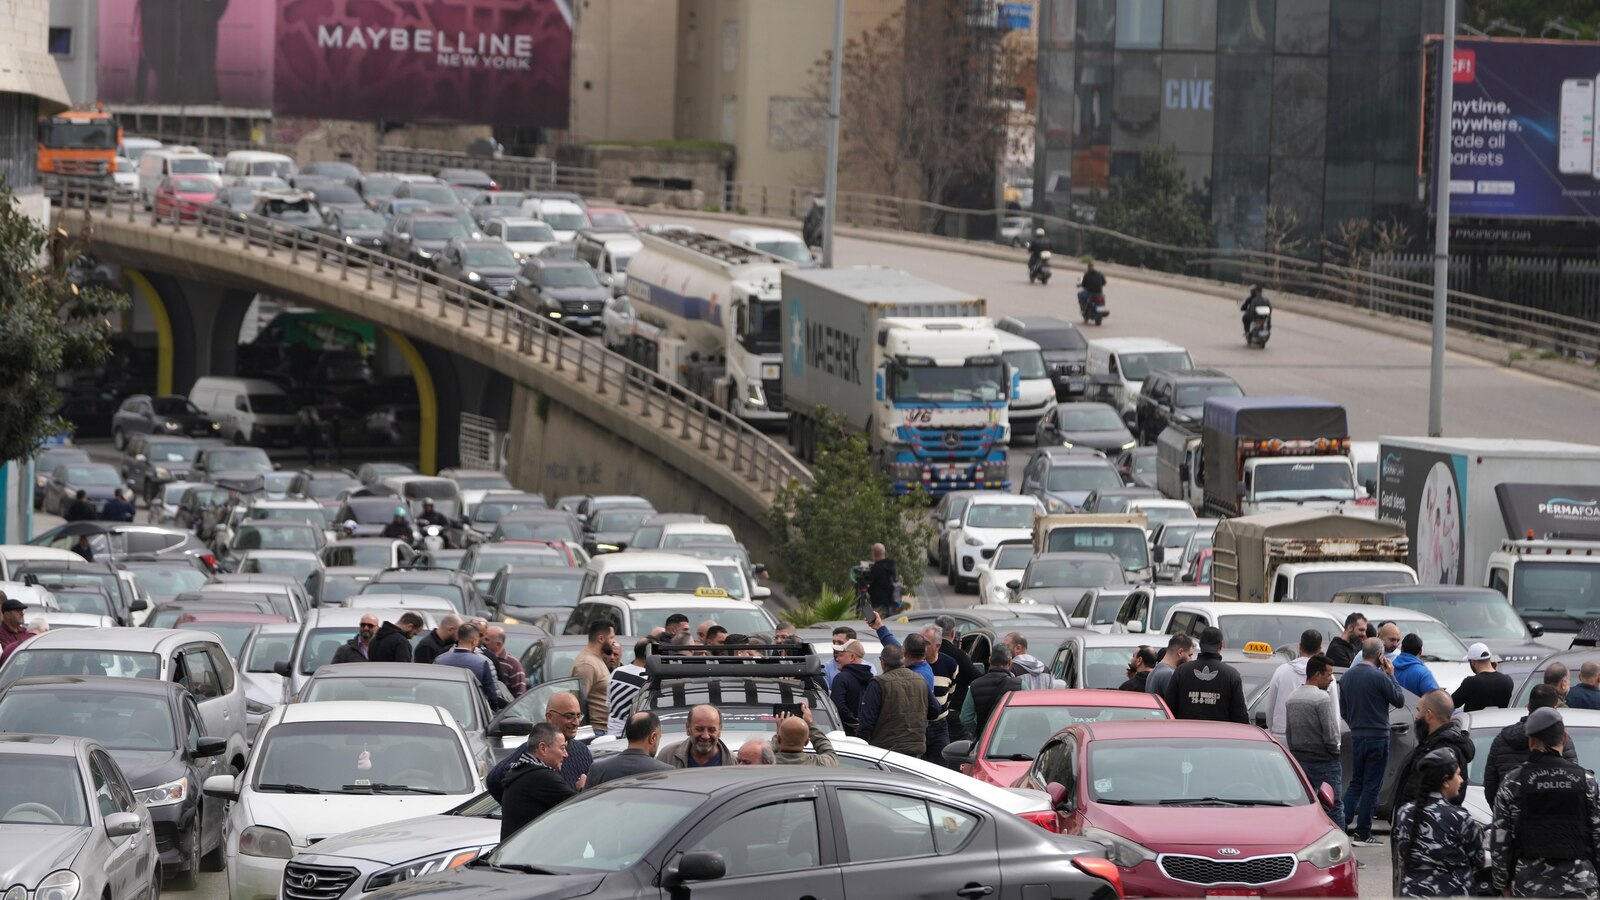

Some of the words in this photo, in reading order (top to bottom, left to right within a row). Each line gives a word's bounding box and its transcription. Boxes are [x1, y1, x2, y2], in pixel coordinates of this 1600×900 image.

[318, 25, 533, 57] MAYBELLINE
[437, 53, 477, 67] NEW
[482, 56, 532, 71] YORK
[1452, 97, 1511, 117] nytime.
[1452, 115, 1523, 134] nywhere.
[1450, 133, 1485, 148] rade
[1488, 133, 1505, 149] all
[804, 317, 863, 386] MAERSK
[1381, 490, 1393, 508] Great
[1538, 502, 1600, 517] PERMAFOA
[1249, 643, 1269, 652] TAXI
[1537, 780, 1572, 790] POLICE
